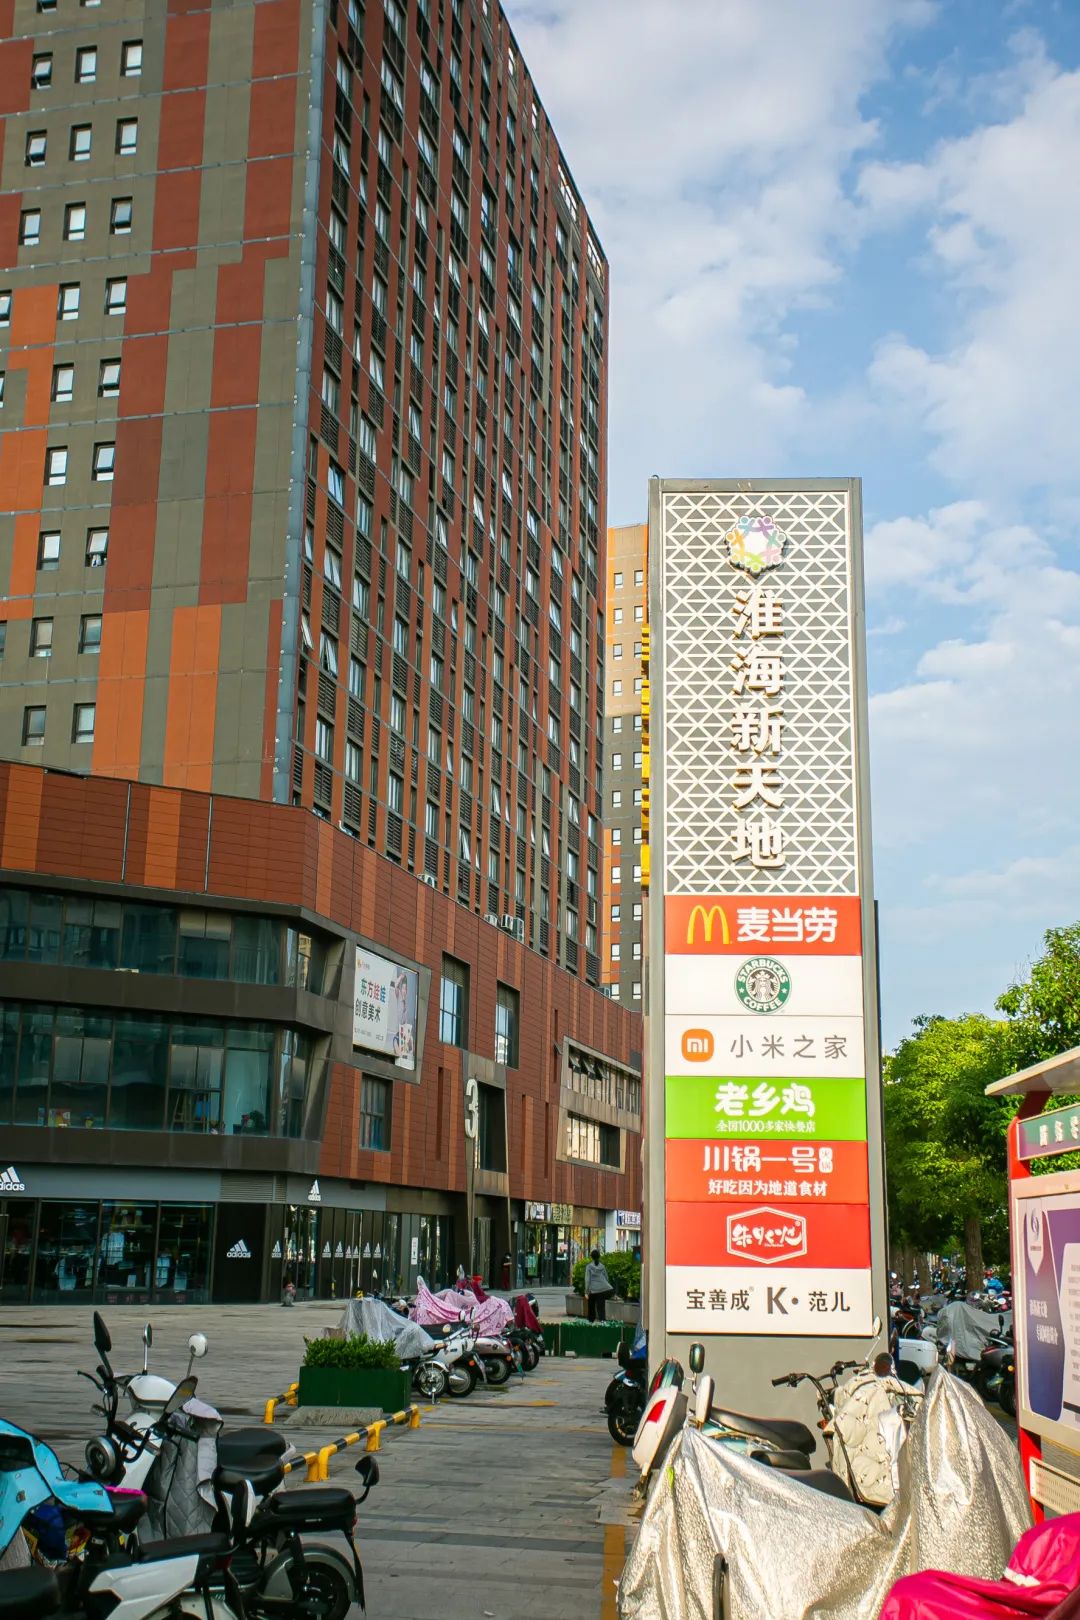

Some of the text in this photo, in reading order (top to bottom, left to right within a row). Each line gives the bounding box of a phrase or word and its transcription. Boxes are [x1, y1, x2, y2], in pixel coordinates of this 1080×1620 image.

[731, 587, 785, 869] 淮海新天地
[736, 906, 838, 943] 麦当劳
[737, 958, 789, 983] STARBUCKS
[743, 996, 783, 1011] COFFEE
[729, 1034, 848, 1059] 小米之家
[714, 1081, 816, 1117] 老乡鸡
[703, 1145, 818, 1173] 川锅一号
[708, 1179, 828, 1197] 好吃因为地道食材
[686, 1288, 750, 1312] 宝善成
[808, 1290, 851, 1313] 范儿
